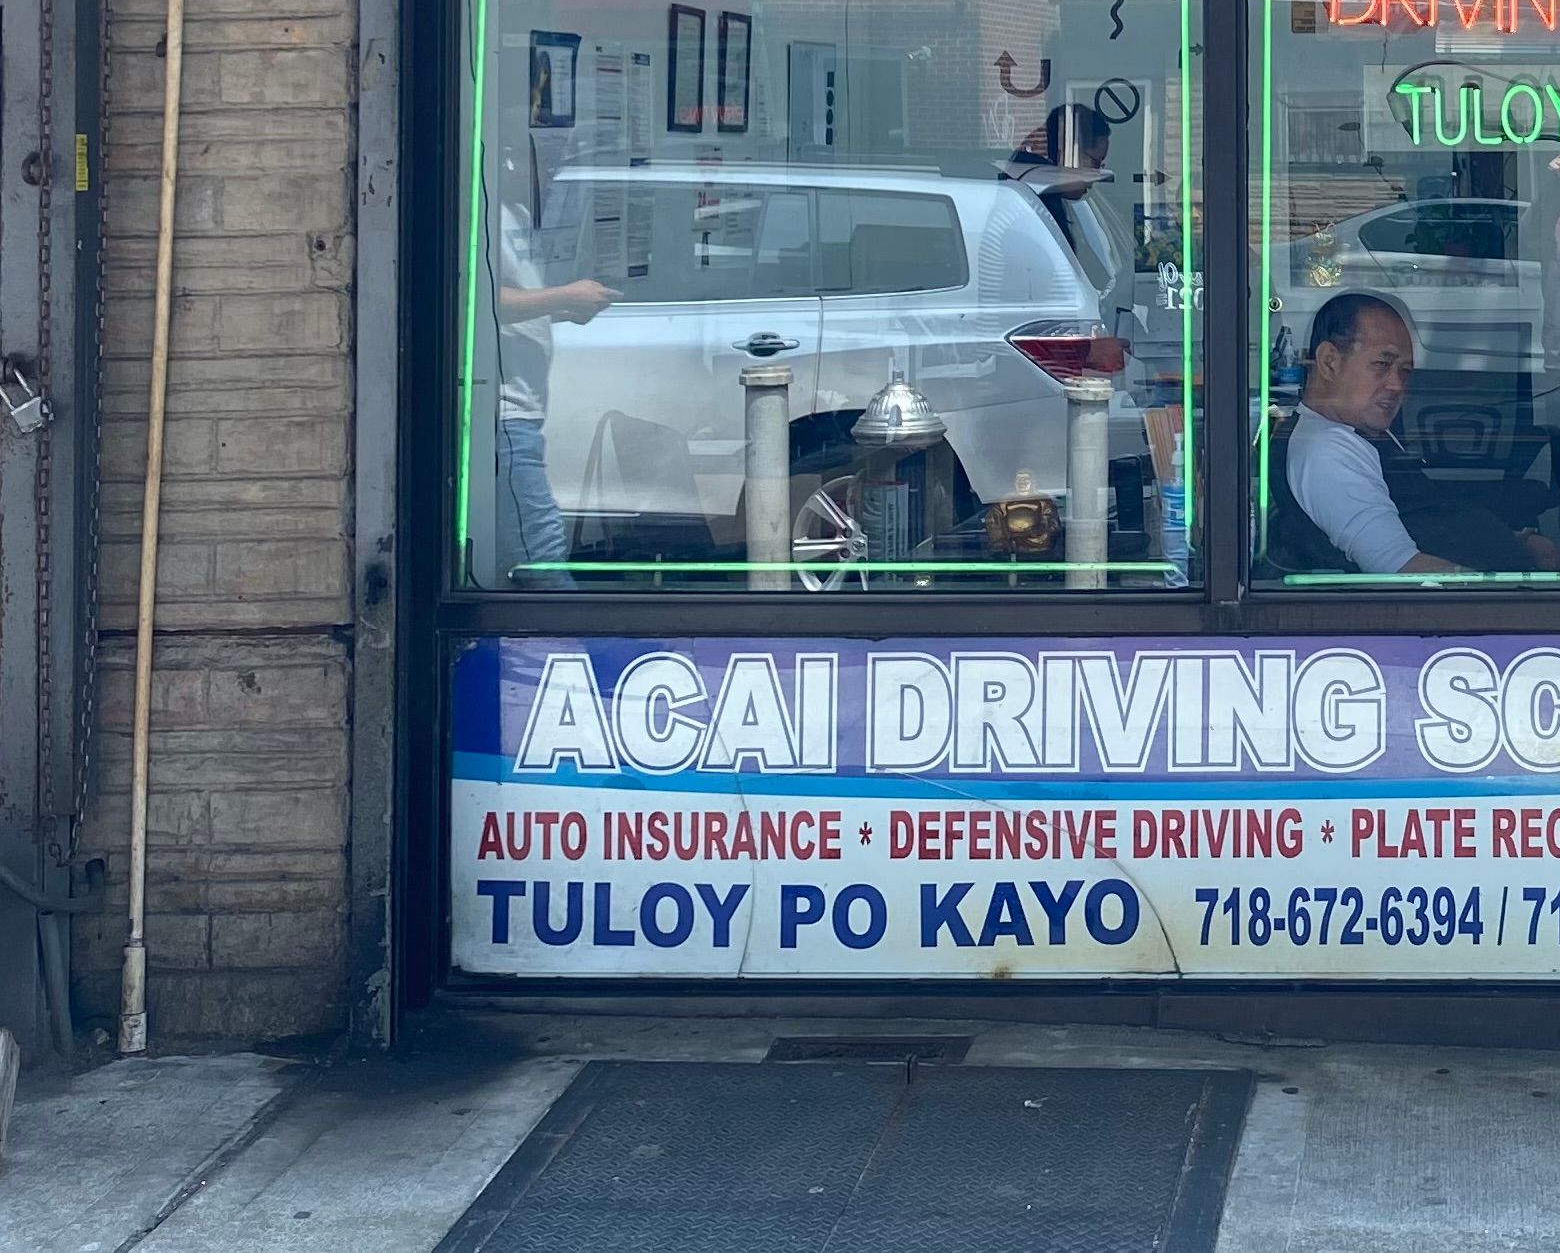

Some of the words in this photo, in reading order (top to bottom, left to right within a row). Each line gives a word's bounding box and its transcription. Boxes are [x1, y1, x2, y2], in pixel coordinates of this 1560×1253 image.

[513, 651, 838, 774] ACAI
[866, 649, 1387, 774] DRIVING
[477, 811, 588, 861] AUTO
[603, 810, 842, 861] INSURANCE
[890, 809, 1118, 861] DEFENSIVE
[1133, 808, 1303, 860] DRIVING
[1351, 808, 1477, 859] PLATE
[477, 879, 754, 948] TULOY
[779, 883, 888, 949] PO
[920, 879, 1140, 947] KAYO
[1195, 886, 1485, 947] 718-672-6394
